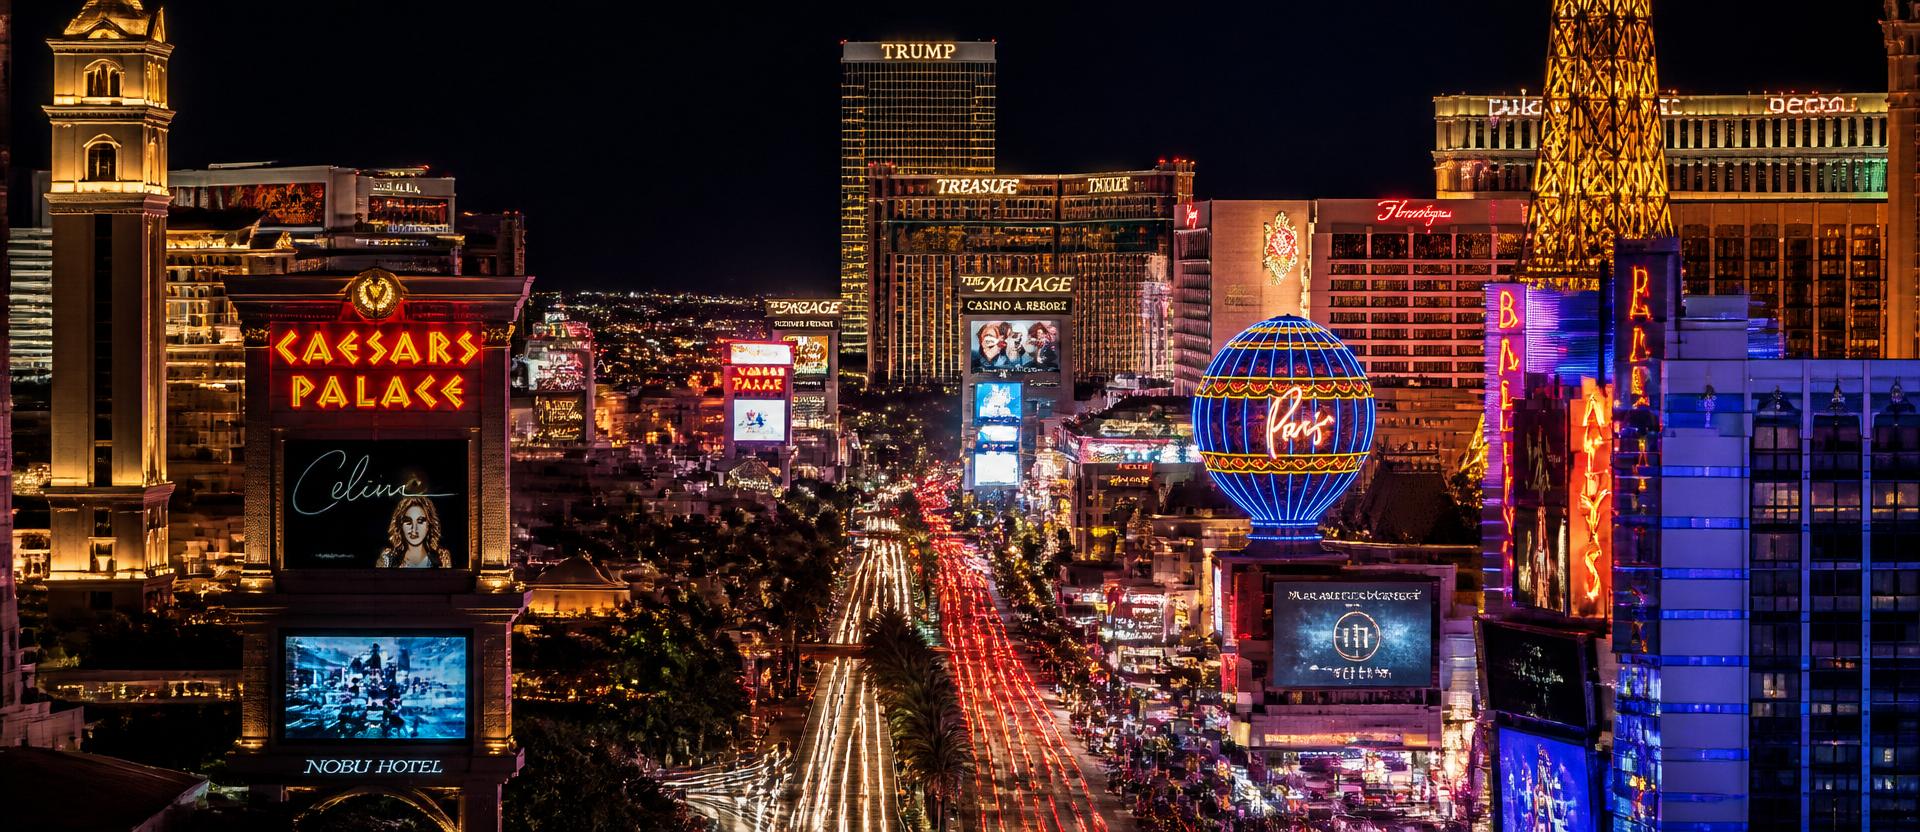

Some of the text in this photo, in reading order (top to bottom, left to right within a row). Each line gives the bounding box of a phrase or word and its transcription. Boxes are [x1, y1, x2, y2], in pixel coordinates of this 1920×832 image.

[881, 43, 956, 59] TRUMP
[974, 276, 1075, 292] MIRAGE
[967, 300, 1012, 311] CASINO
[275, 329, 480, 366] CAESARS
[290, 374, 465, 409] PALACE
[303, 759, 444, 774] NOBU HOTEL
